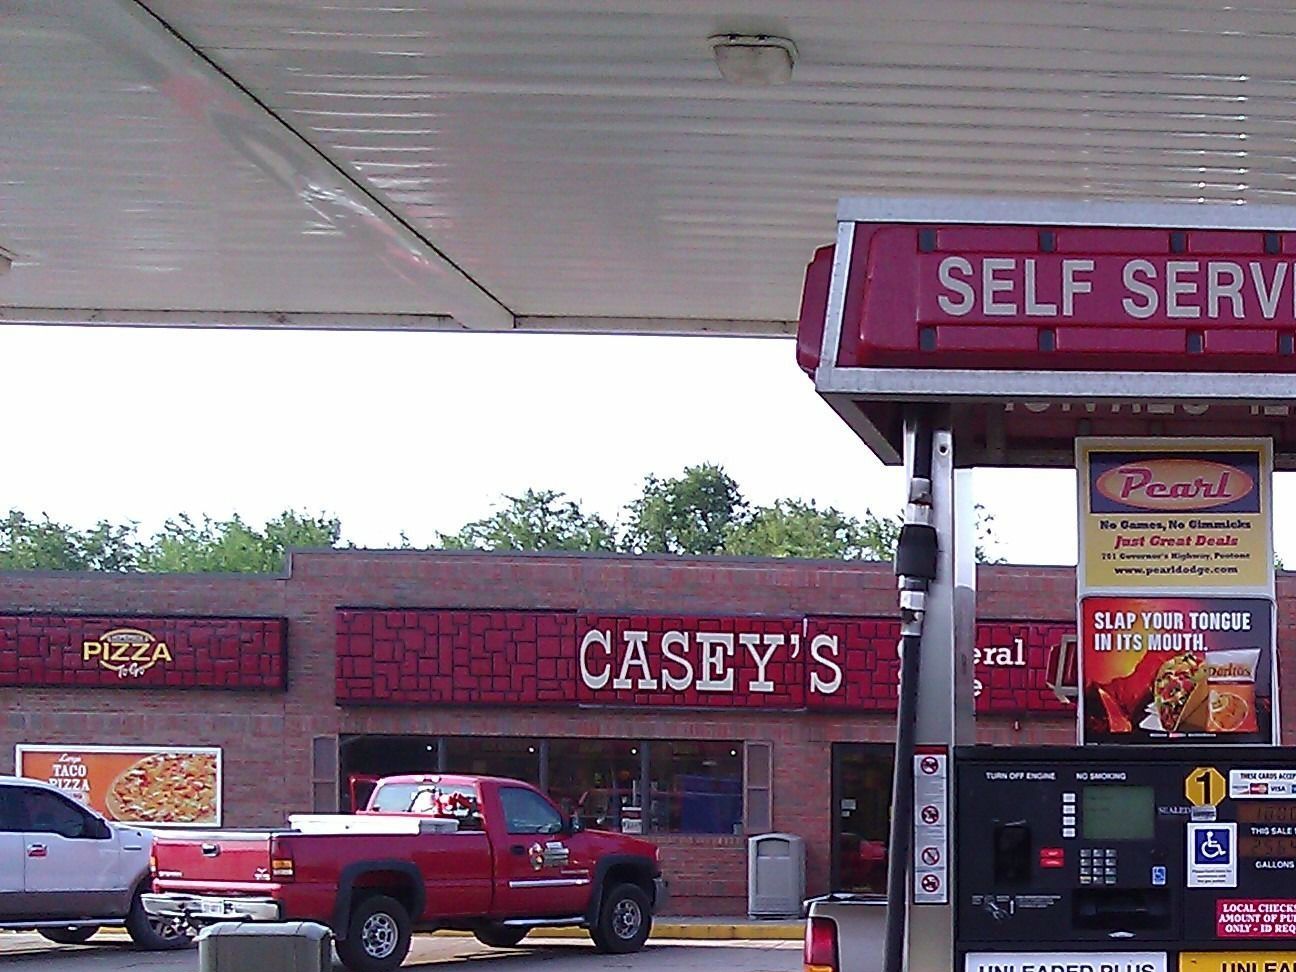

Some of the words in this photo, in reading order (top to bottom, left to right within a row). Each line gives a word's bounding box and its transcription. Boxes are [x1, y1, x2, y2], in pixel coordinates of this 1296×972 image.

[938, 256, 1095, 316] SELF
[1118, 467, 1232, 499] Pearl
[1100, 520, 1117, 530] No
[1120, 520, 1166, 532] Games,
[1168, 520, 1185, 530] No
[1188, 519, 1251, 530] Gimmicks
[1114, 535, 1145, 550] Just
[1149, 535, 1193, 547] Great
[1194, 535, 1239, 547] Deals
[1114, 565, 1239, 577] www.pearldodge.com
[1095, 613, 1136, 630] SLAP
[1141, 613, 1184, 629] YOUR
[1188, 613, 1251, 631] TONGUE
[1094, 634, 1112, 651] IN
[1116, 634, 1143, 651] ITS
[1148, 634, 1208, 652] MOUTH.
[83, 641, 172, 662] PIZZA
[580, 629, 842, 694] CASEY'S
[53, 764, 87, 777] TACO
[1009, 772, 1024, 780] OFF
[1076, 772, 1088, 780] NO
[48, 778, 91, 791] PIZZA
[1196, 771, 1211, 805] 1
[1158, 806, 1191, 814] SEALED
[1250, 827, 1270, 835] THIS
[1271, 827, 1292, 835] SALE
[1255, 861, 1295, 869] GALLONS
[1222, 903, 1257, 913] LOCAL
[1218, 913, 1262, 923] AMOUNT
[1262, 913, 1278, 923] OF
[1224, 923, 1251, 933] ONLY
[1260, 923, 1272, 933] ID
